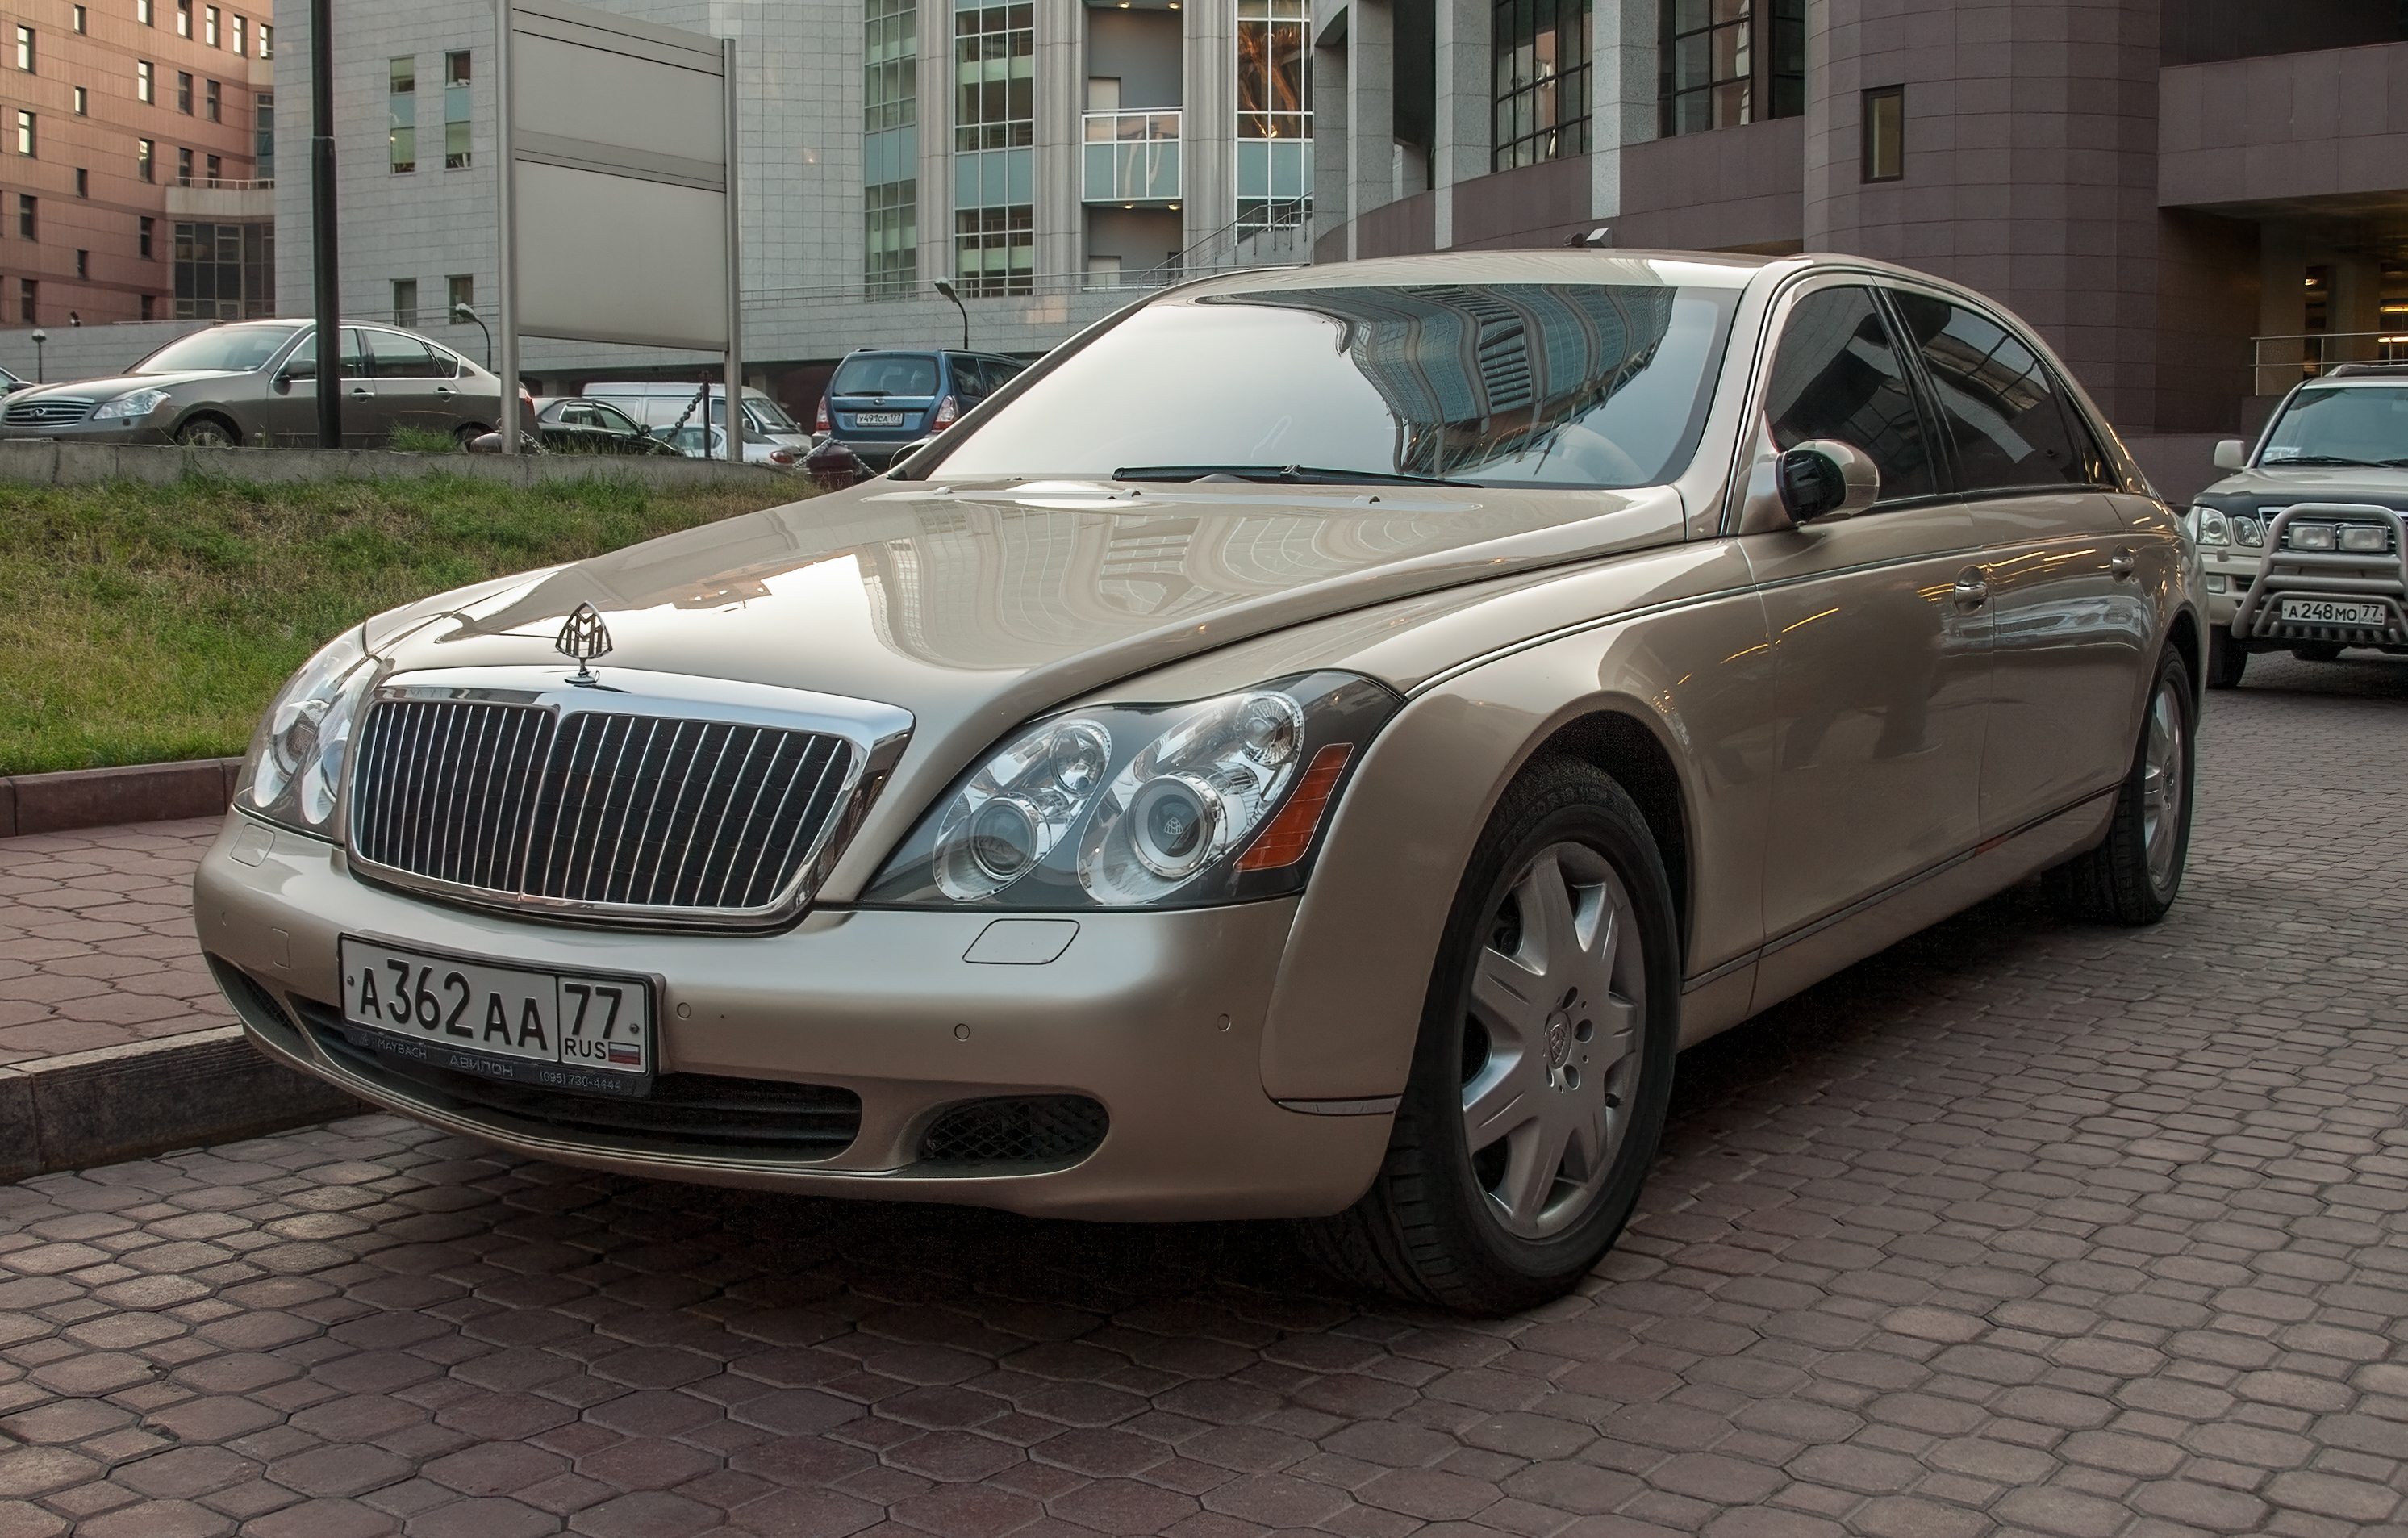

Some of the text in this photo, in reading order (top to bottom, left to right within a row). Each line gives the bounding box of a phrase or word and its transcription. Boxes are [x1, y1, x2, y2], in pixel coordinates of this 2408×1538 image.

[2288, 603, 2379, 622] А248МО 77
[360, 958, 622, 1051] А362АА 77
[378, 1039, 428, 1060] MAYBACH
[565, 1038, 606, 1059] RUS
